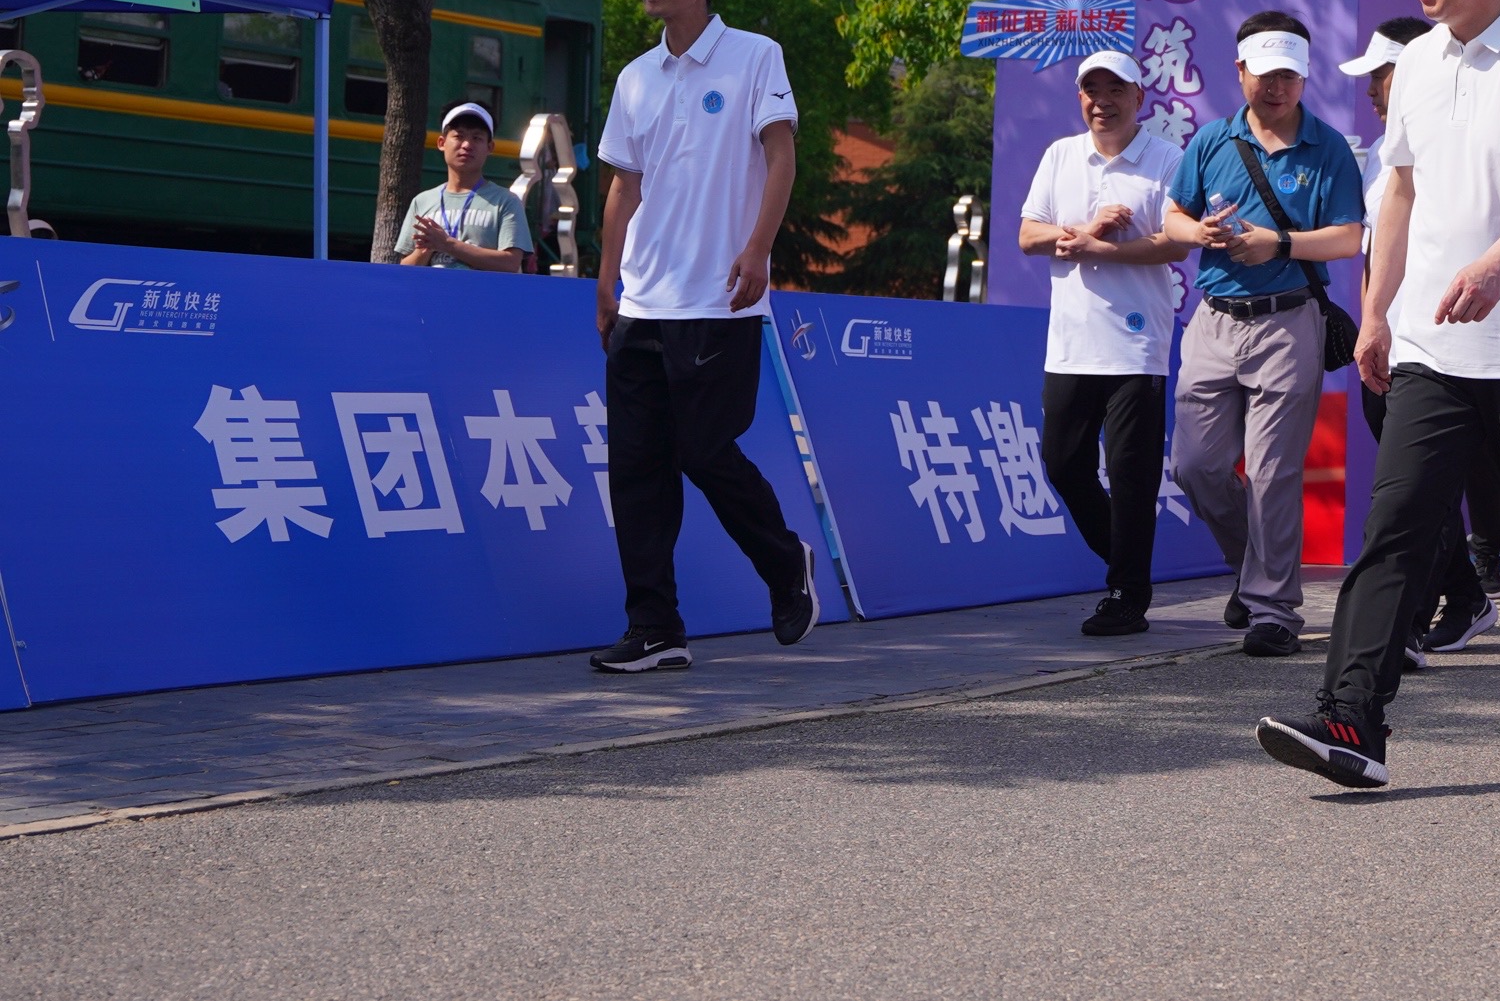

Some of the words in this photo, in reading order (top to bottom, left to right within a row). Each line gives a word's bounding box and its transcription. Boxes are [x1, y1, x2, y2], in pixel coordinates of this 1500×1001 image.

[976, 9, 1047, 33] 新征程
[1055, 9, 1127, 32] 新出发
[141, 289, 221, 312] 新城快线
[139, 310, 154, 318] NEW
[155, 311, 189, 319] INTERCITY
[190, 312, 218, 320] EXPRESS
[873, 326, 913, 343] 新城快线
